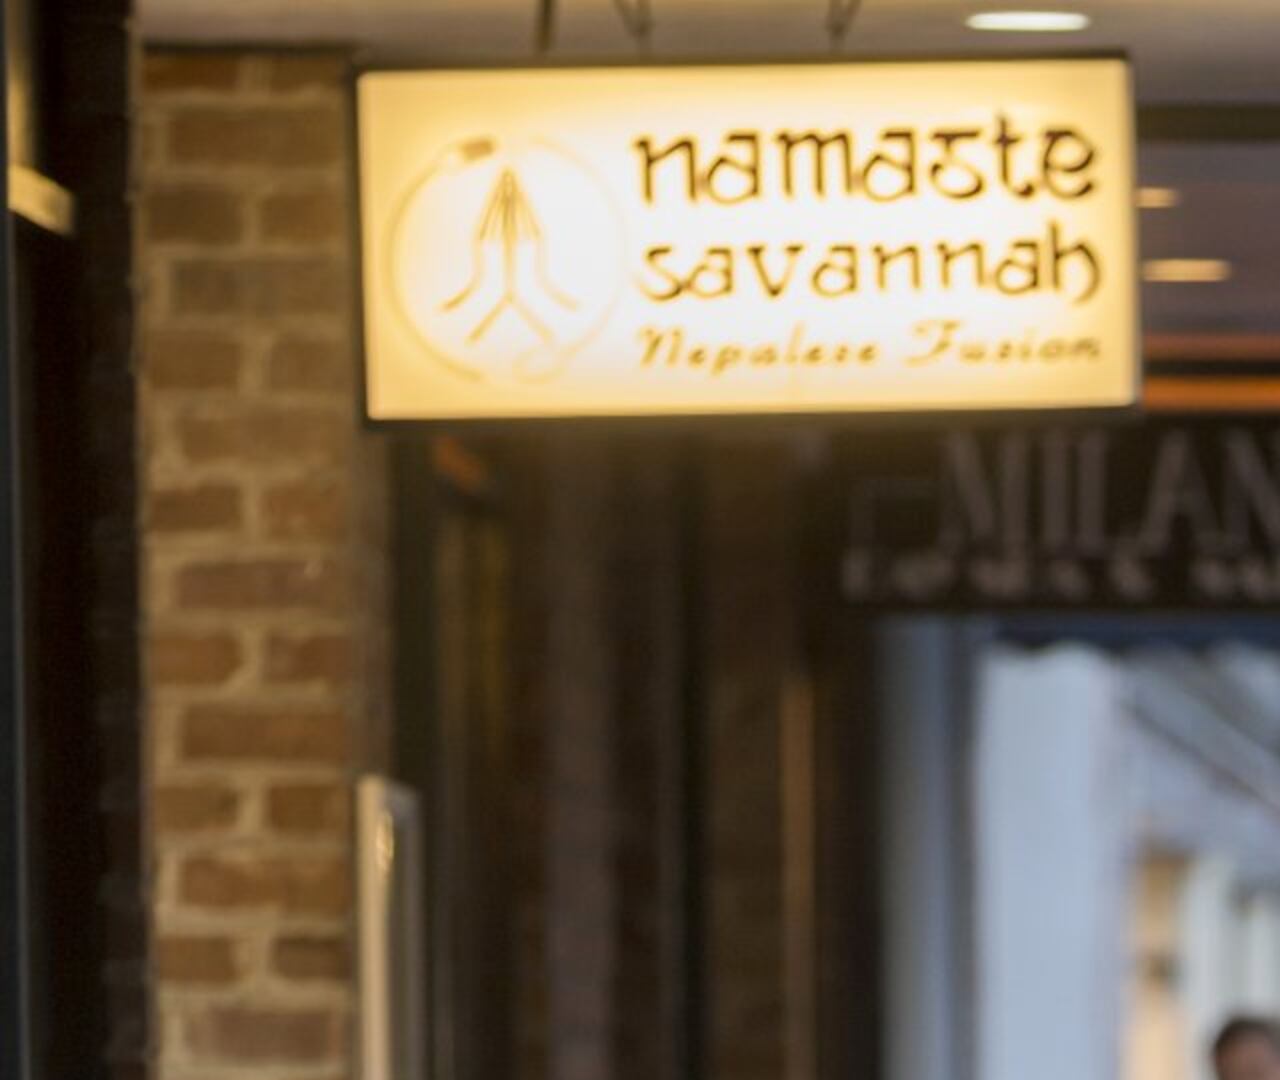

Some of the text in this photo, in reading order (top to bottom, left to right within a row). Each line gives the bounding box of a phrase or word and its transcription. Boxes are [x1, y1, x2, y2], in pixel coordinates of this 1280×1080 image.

[634, 111, 1098, 204] namaste
[641, 221, 1101, 305] savannah
[637, 317, 1102, 377] Nepalese Fusion
